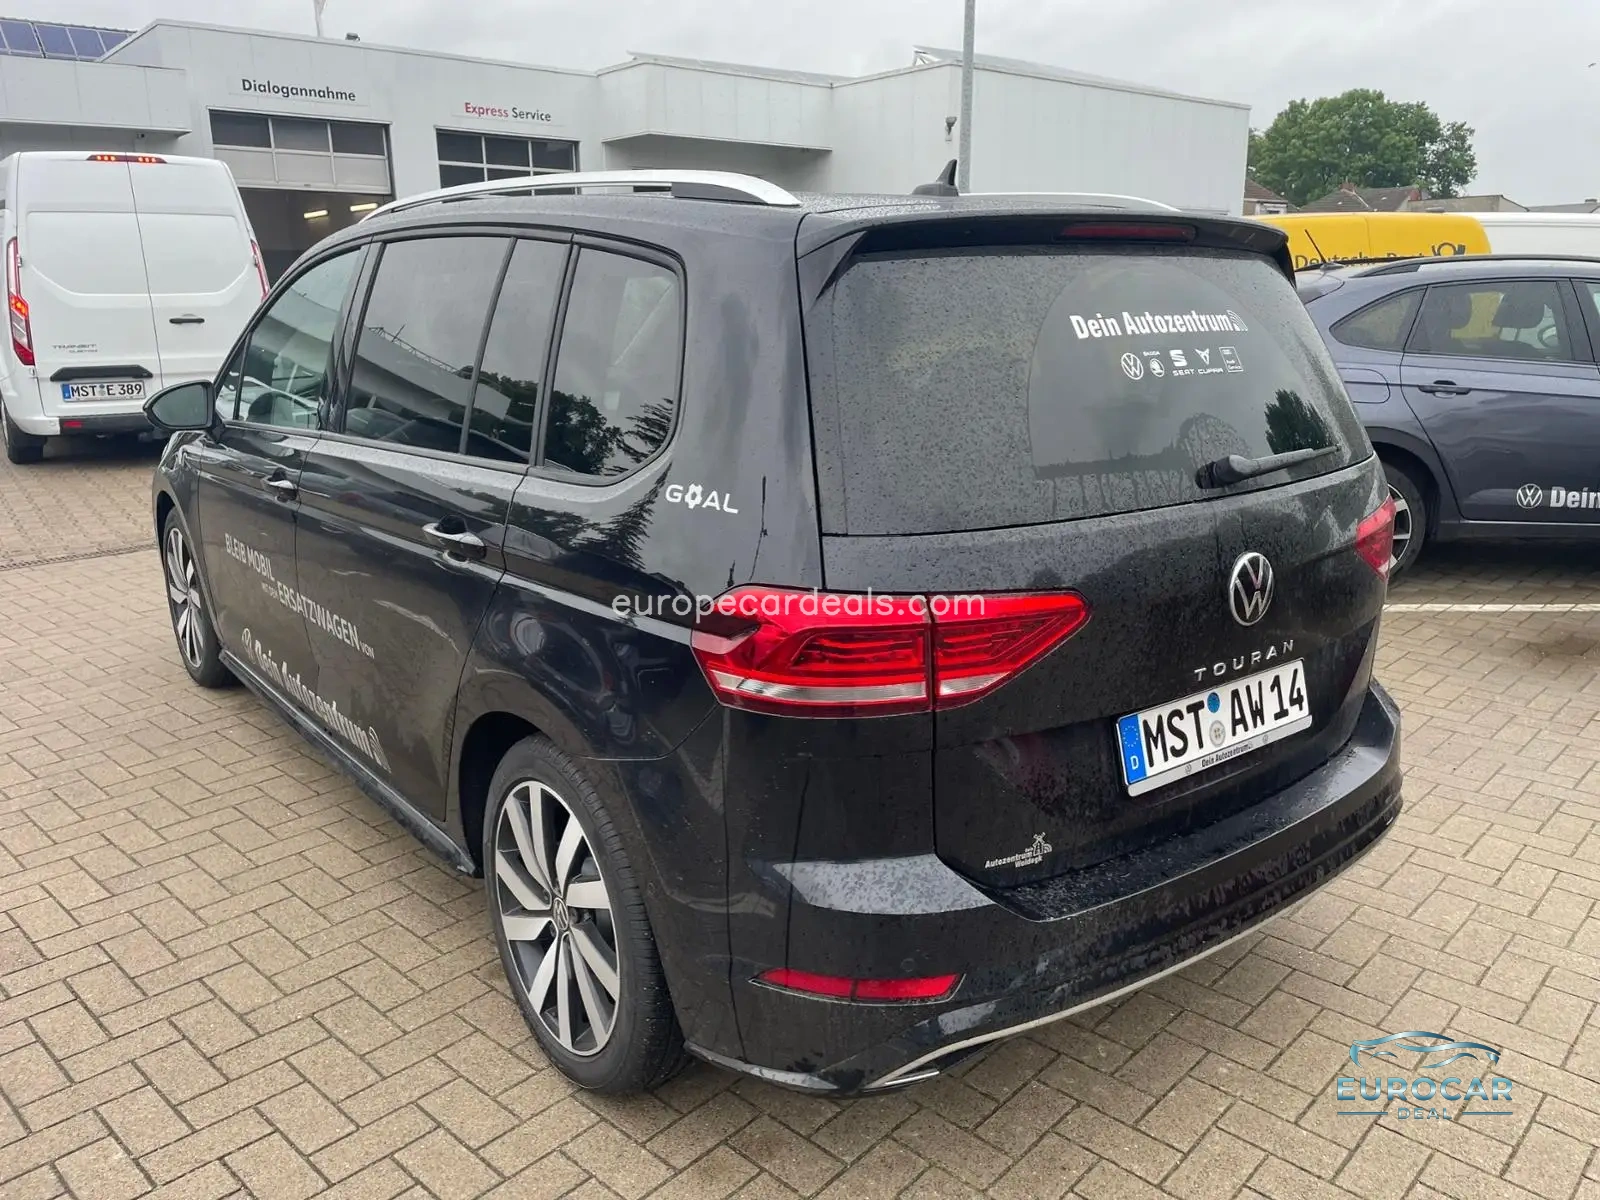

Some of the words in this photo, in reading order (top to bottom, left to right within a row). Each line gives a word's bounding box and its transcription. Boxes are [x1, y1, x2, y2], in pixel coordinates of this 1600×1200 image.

[241, 79, 356, 101] Dialogannahme
[464, 102, 509, 119] Express
[511, 107, 552, 122] Service
[1069, 313, 1122, 339] Dein
[1122, 310, 1237, 335] Autozentrum
[71, 385, 97, 397] MST
[106, 384, 116, 396] E
[118, 383, 142, 395] 389
[225, 533, 247, 563] BLEIB
[247, 546, 275, 582] MOBIL
[277, 581, 361, 651] ERSATZWAGEN
[1194, 639, 1294, 682] TOURAN
[1142, 700, 1206, 768] MST
[1230, 681, 1265, 737] AW
[1270, 668, 1304, 721] 14
[1130, 755, 1139, 770] D
[1201, 756, 1215, 767] Dein
[984, 851, 1033, 868] Autozentrum
